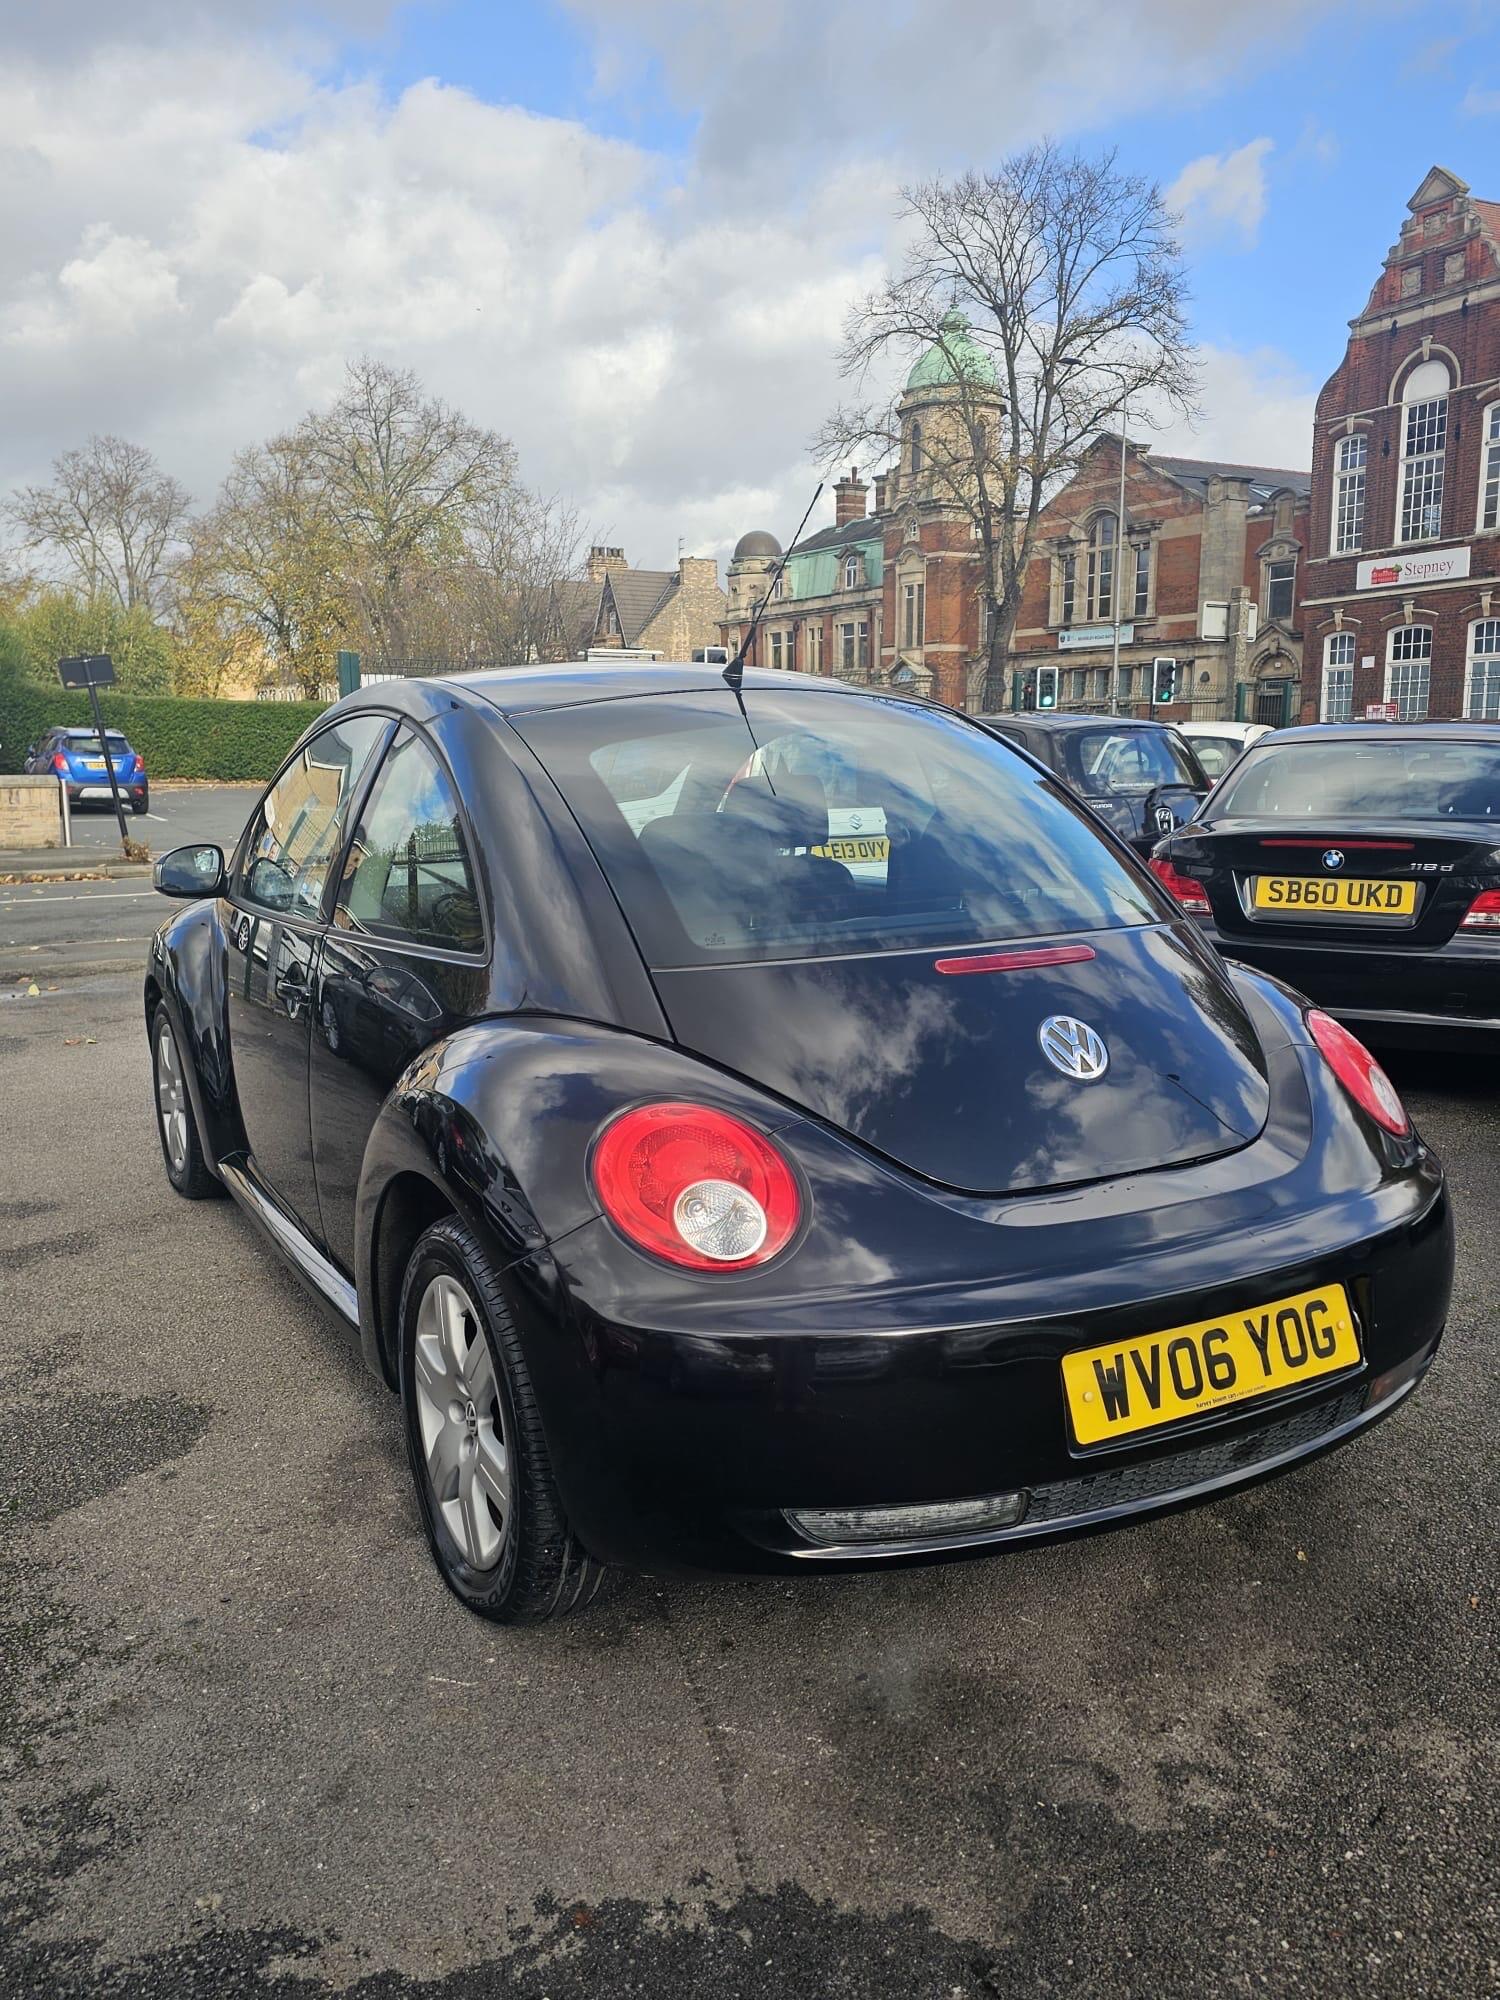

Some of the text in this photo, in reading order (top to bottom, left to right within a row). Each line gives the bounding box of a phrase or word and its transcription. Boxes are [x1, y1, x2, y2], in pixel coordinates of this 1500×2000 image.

[1404, 560, 1454, 578] Stepney
[859, 841, 885, 858] OVY
[1268, 880, 1403, 908] SB60 UKD
[1092, 1299, 1336, 1422] WV06 YOG
